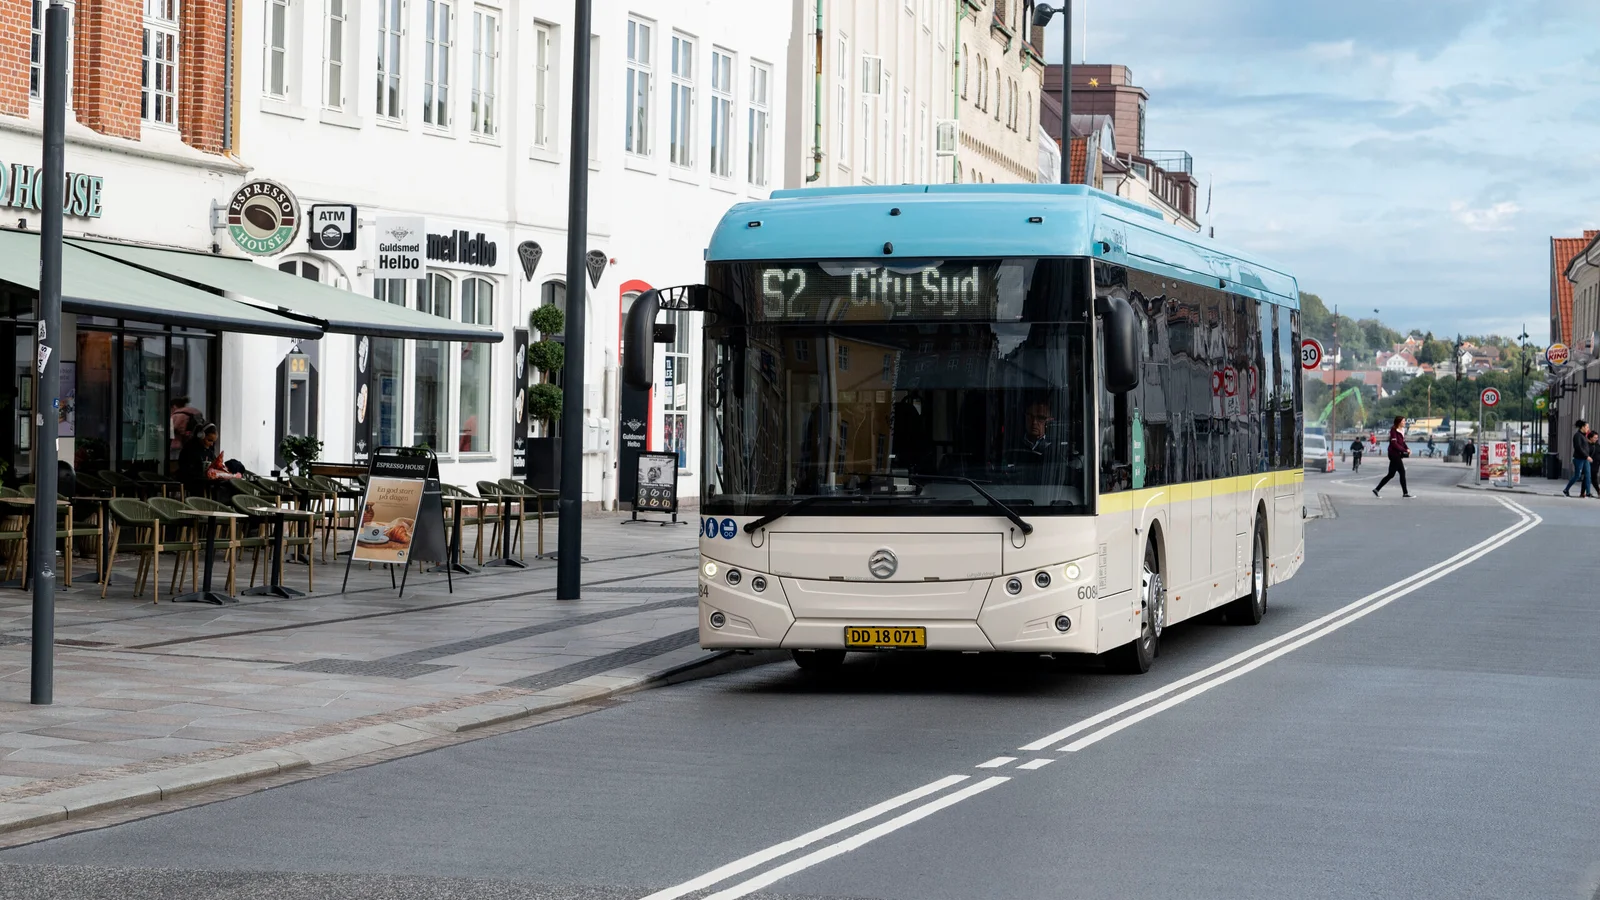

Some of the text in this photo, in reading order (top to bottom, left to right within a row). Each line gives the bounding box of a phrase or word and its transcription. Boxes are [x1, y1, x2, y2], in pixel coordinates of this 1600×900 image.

[232, 184, 291, 212] ESPRESSO
[319, 211, 345, 221] ATM
[237, 232, 283, 251] HOUSE
[379, 243, 420, 252] Guldsmed
[426, 229, 497, 267] med Helbo
[379, 255, 420, 269] Helbo
[763, 266, 979, 317] S2 City Syd
[1302, 349, 1317, 361] 30
[376, 461, 404, 469] ESPRESSO
[851, 630, 918, 643] DD 18 071
